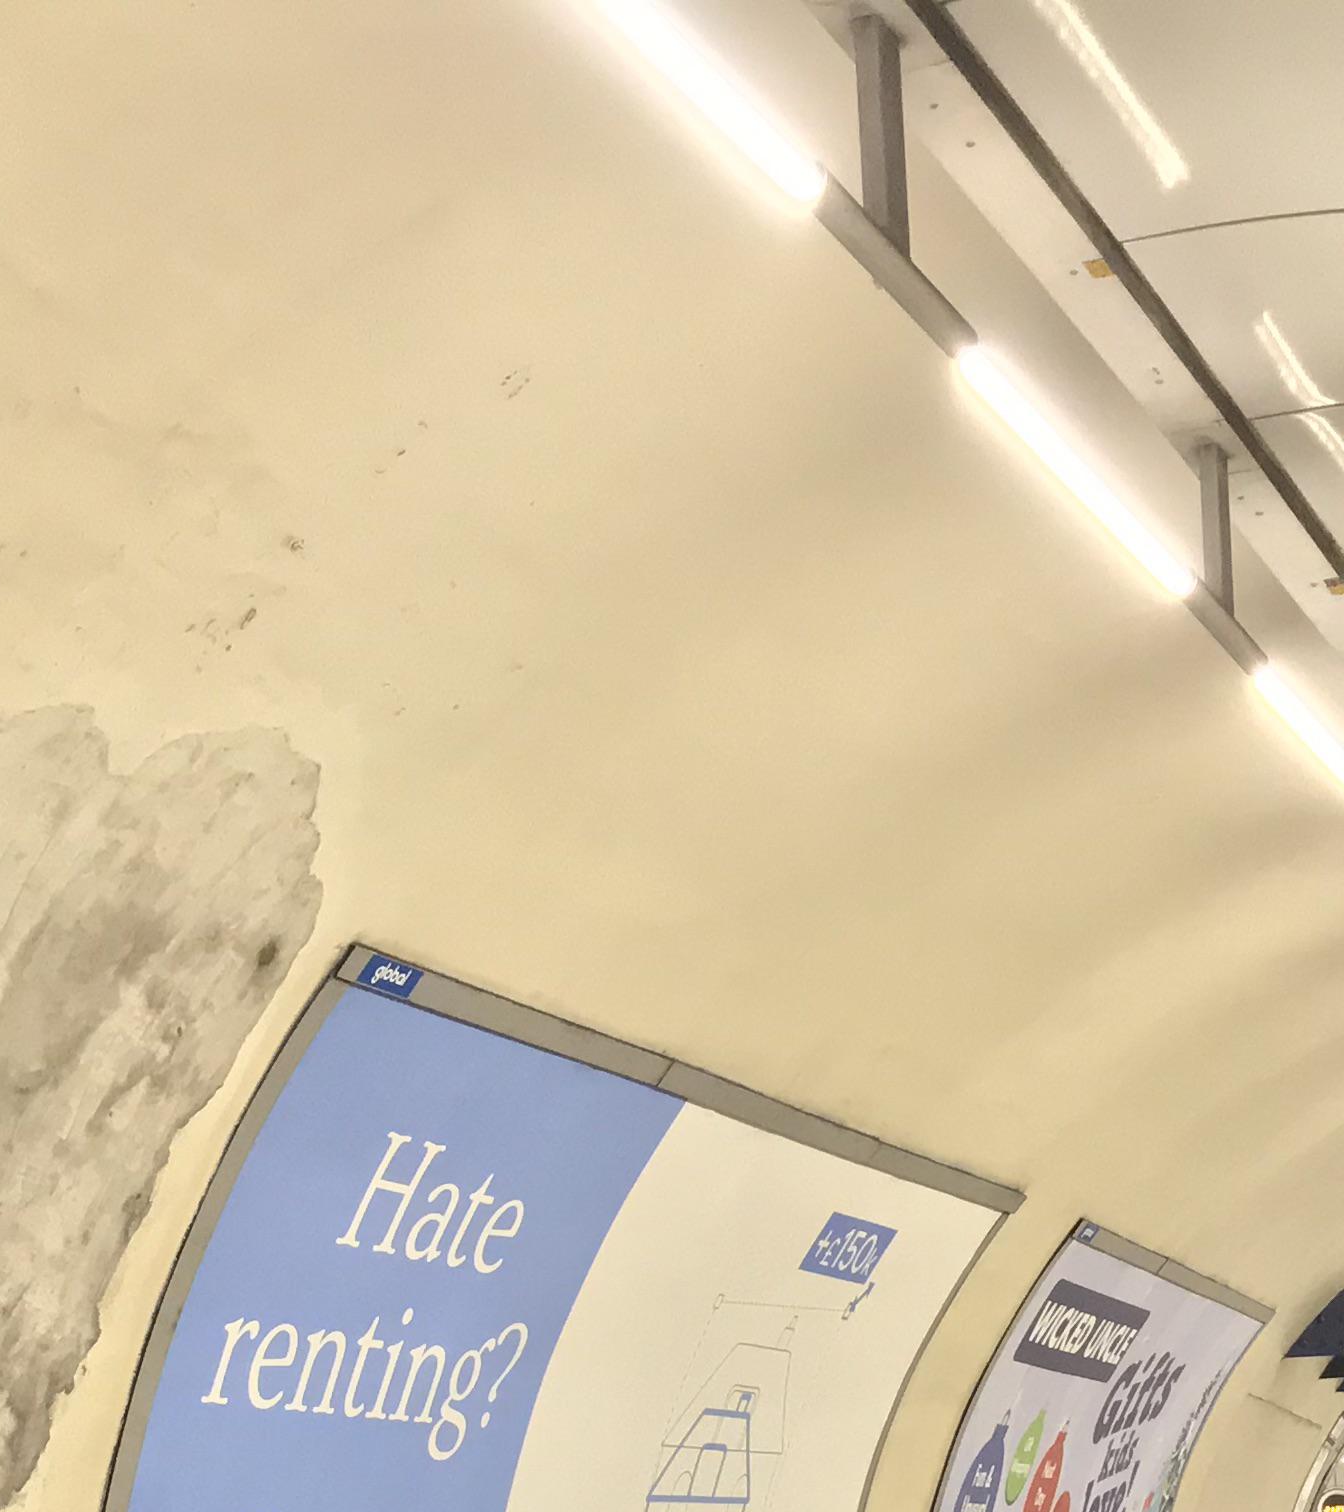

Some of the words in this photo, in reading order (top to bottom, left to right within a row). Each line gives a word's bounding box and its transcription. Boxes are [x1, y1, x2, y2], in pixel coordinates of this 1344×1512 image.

[371, 962, 412, 986] global
[336, 1131, 524, 1274] Hate
[815, 1229, 878, 1276] +£150k
[1029, 1301, 1097, 1354] WICKED
[1084, 1319, 1138, 1365] UNCLE
[201, 1307, 529, 1460] renting?
[1093, 1352, 1186, 1444] Gifts
[1097, 1430, 1140, 1483] kids
